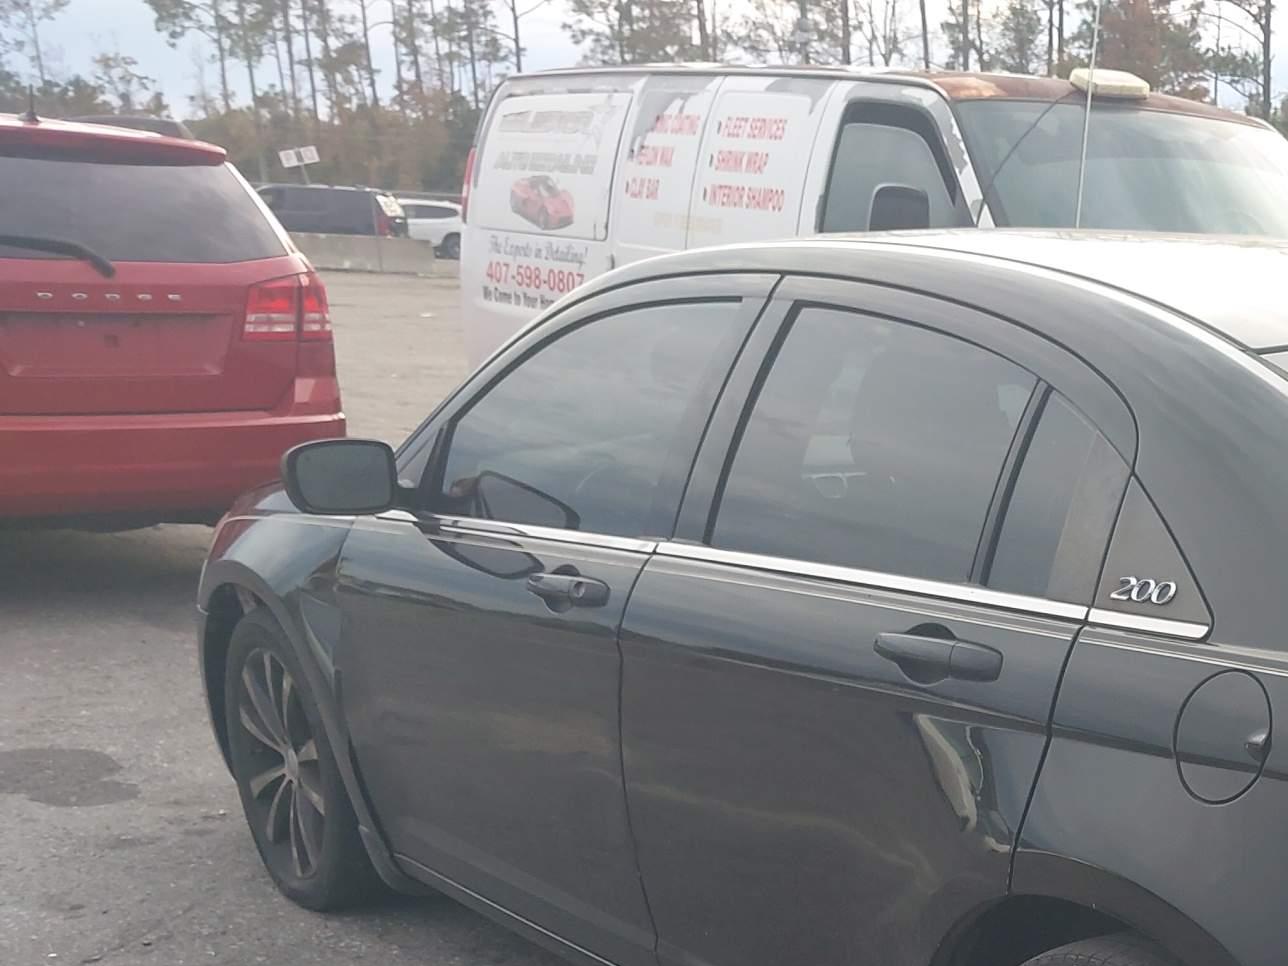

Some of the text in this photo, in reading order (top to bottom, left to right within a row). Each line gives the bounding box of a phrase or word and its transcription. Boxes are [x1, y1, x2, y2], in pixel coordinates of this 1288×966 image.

[722, 116, 787, 140] FLEET SERVICES
[715, 149, 769, 174] SHRINK WRAP
[645, 177, 660, 200] BAR
[708, 183, 785, 212] INTERIOR SHAMPOO
[485, 261, 585, 293] 407-598-0807
[1110, 576, 1176, 604] 200
